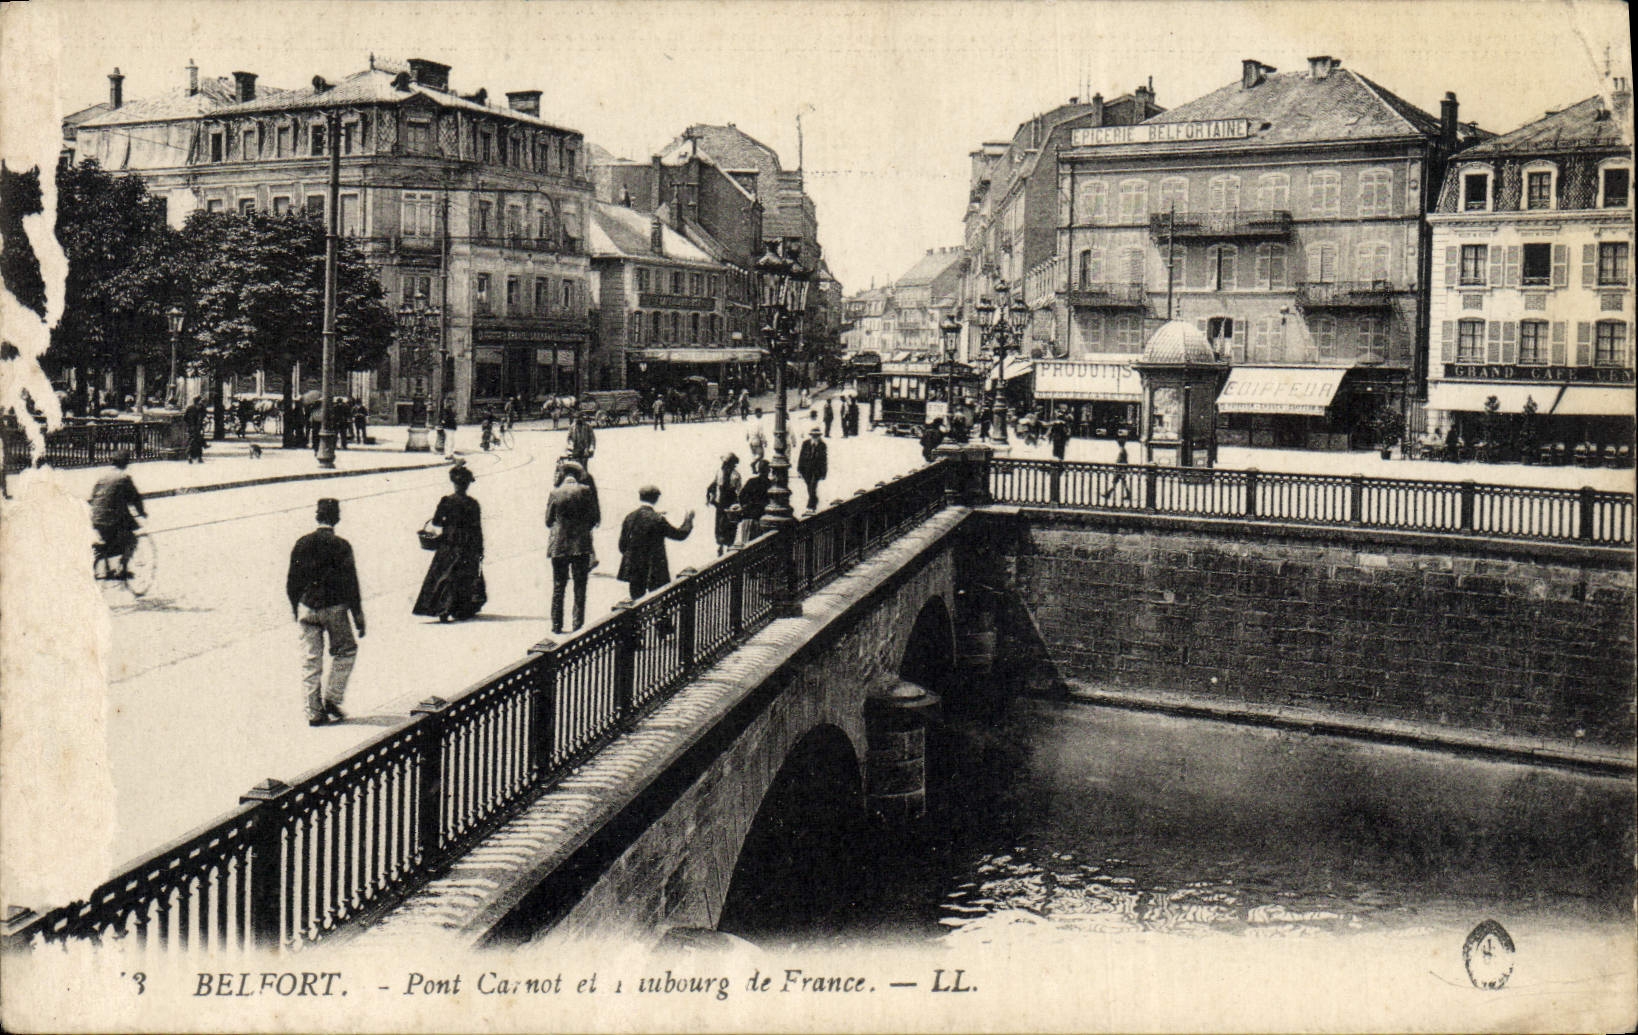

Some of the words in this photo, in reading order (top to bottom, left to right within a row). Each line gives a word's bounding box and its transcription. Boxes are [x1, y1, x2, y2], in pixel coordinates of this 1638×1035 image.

[1073, 128, 1135, 146] EPICERIE
[1150, 119, 1246, 141] BELFORTAINE
[1041, 363, 1133, 379] PRODUITS
[1455, 366, 1514, 379] GRAND
[1223, 380, 1335, 398] COIFFEUR
